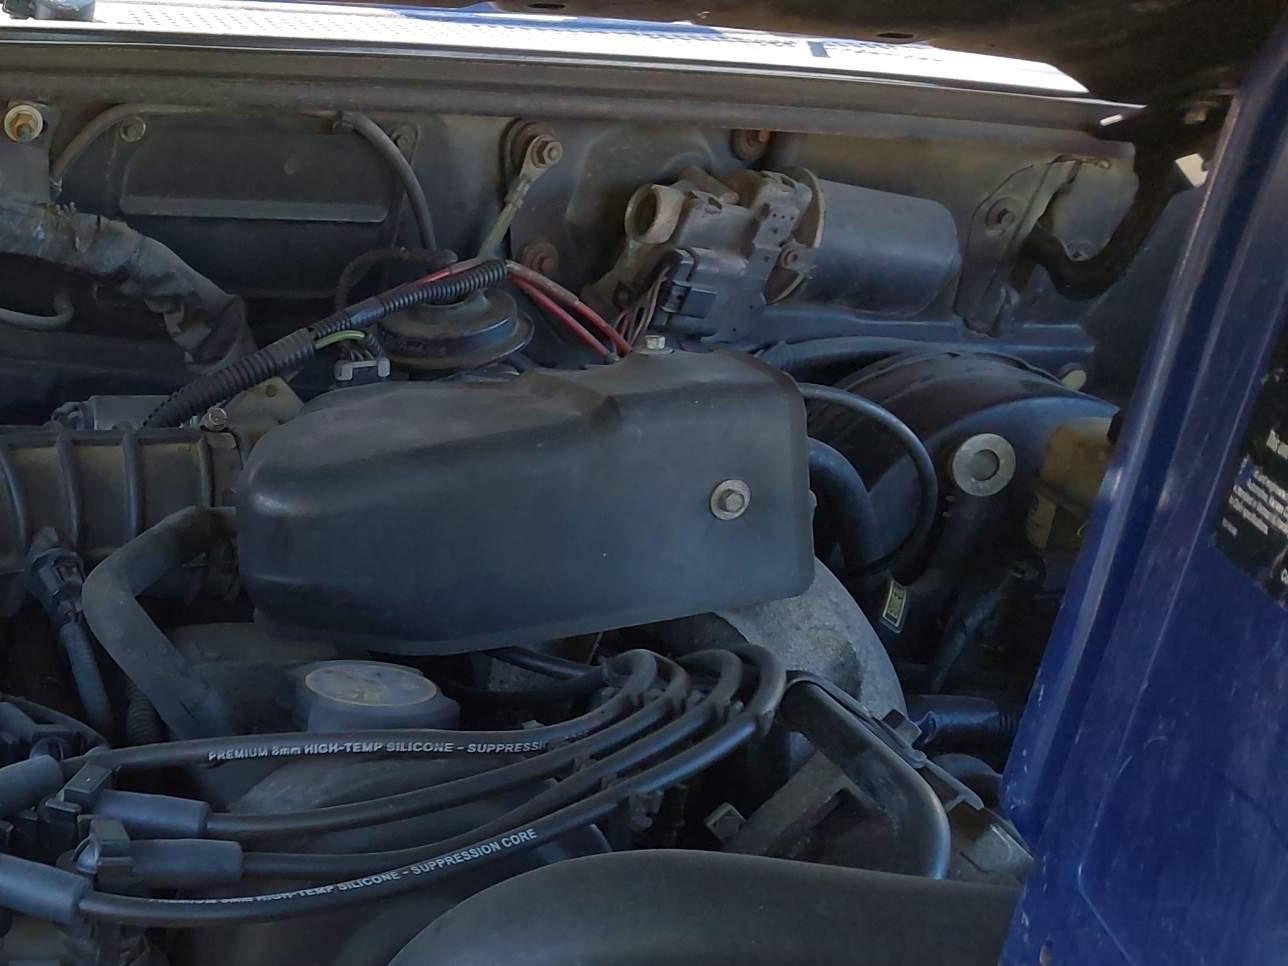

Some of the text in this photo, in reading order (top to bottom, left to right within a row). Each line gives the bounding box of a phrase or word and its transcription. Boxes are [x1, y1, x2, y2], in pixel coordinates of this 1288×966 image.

[208, 748, 269, 761] PREMIUM
[271, 746, 301, 757] 8mm
[304, 742, 383, 754] HIGH-TEMP
[386, 742, 454, 752] SILICONE
[337, 870, 401, 891] SILICONE
[411, 841, 502, 876] SUPPRESSION
[501, 828, 538, 848] CORE
